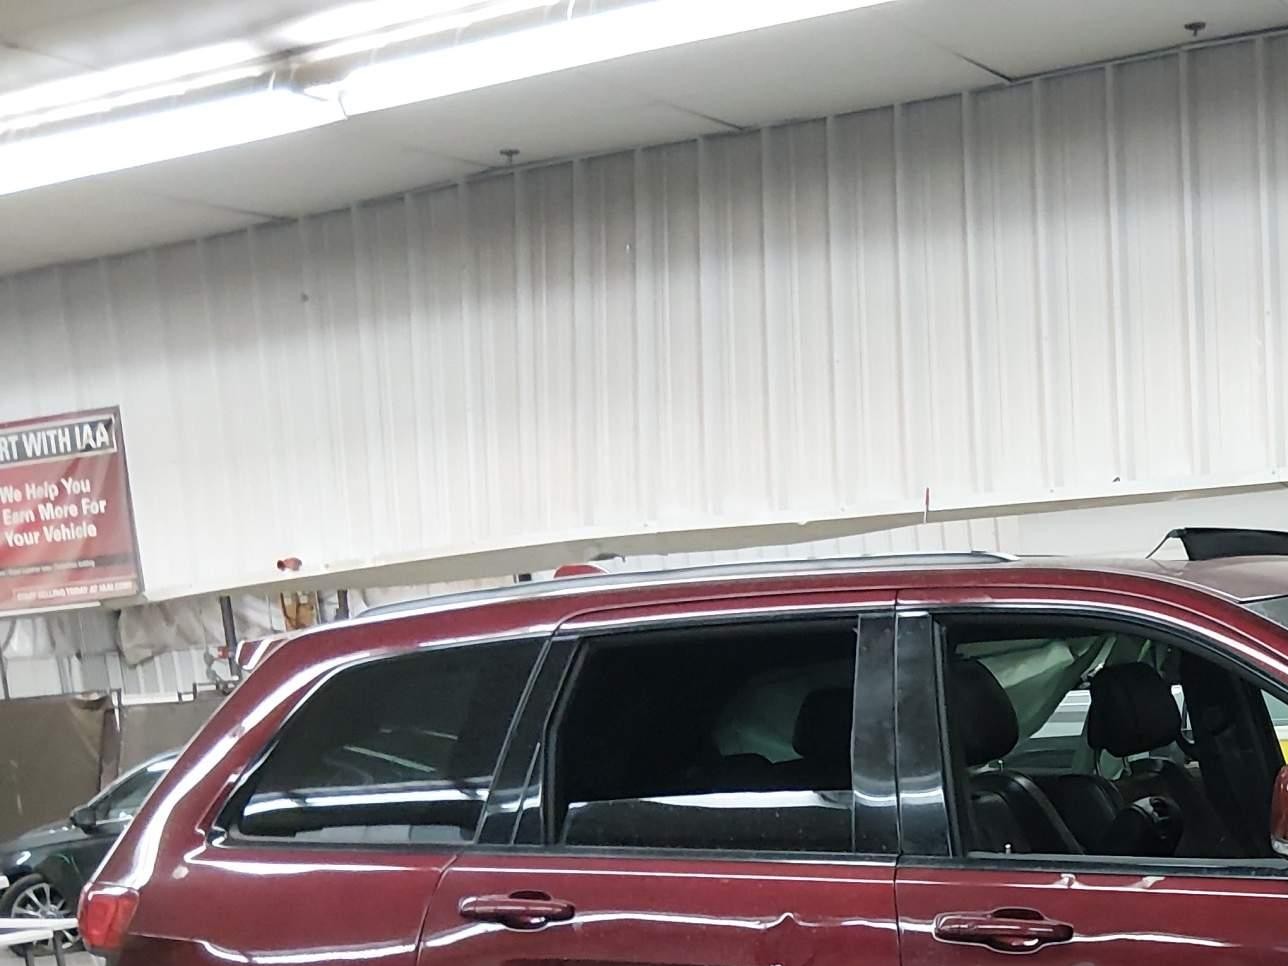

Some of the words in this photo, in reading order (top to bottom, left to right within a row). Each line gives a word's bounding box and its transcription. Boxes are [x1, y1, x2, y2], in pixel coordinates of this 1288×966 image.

[21, 426, 71, 458] WITH
[74, 422, 109, 450] IAA
[0, 485, 22, 504] We
[25, 481, 59, 501] Help
[61, 476, 91, 495] You
[2, 508, 35, 526] Earn
[37, 502, 79, 521] More
[81, 497, 107, 515] For
[4, 531, 40, 548] Your
[42, 521, 97, 543] Vehicle
